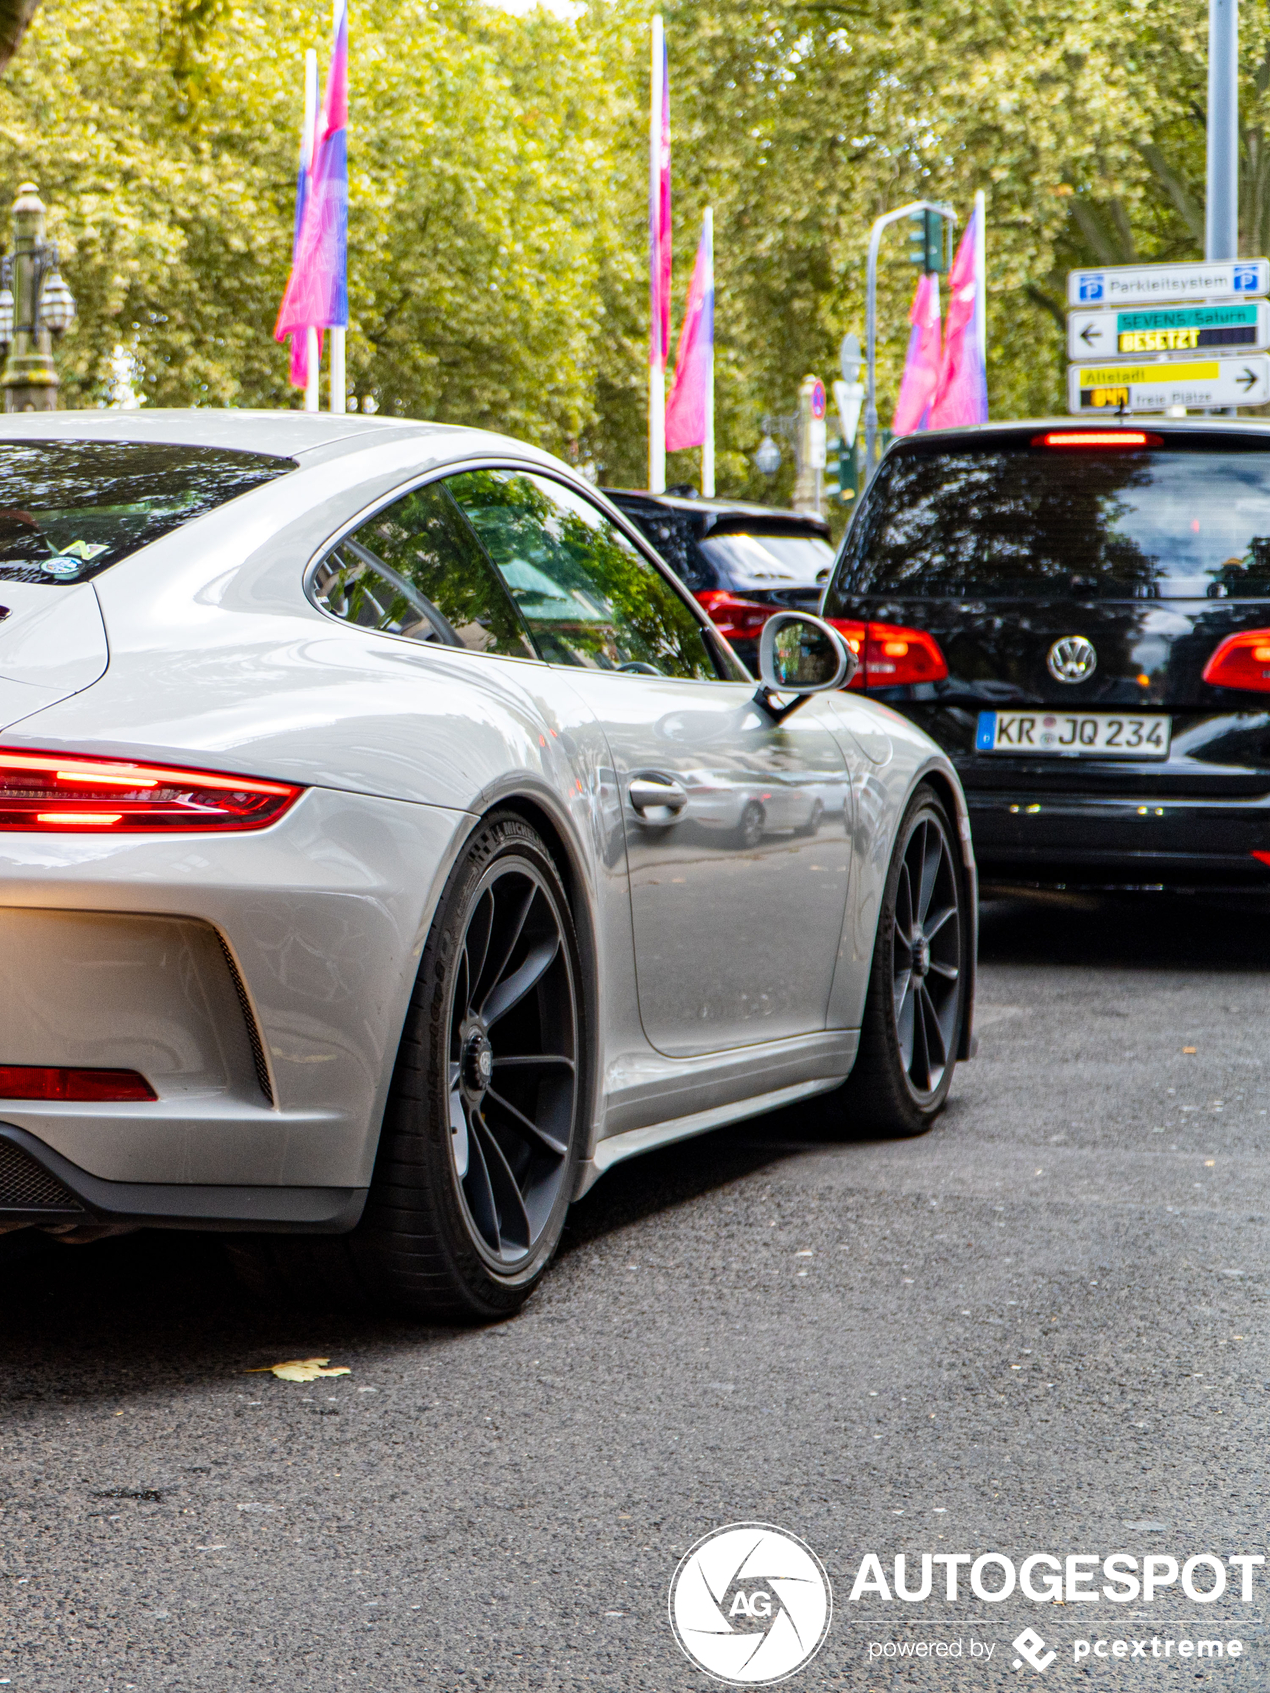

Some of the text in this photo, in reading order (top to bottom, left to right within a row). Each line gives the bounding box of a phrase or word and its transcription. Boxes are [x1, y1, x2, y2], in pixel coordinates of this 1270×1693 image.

[1110, 276, 1228, 294] Parkleitsystem
[1121, 327, 1200, 352] BESETZT
[1086, 369, 1145, 384] Altstadt
[1136, 393, 1166, 407] freie
[1171, 390, 1213, 406] Plätze
[997, 717, 1163, 748] KR JQ 234
